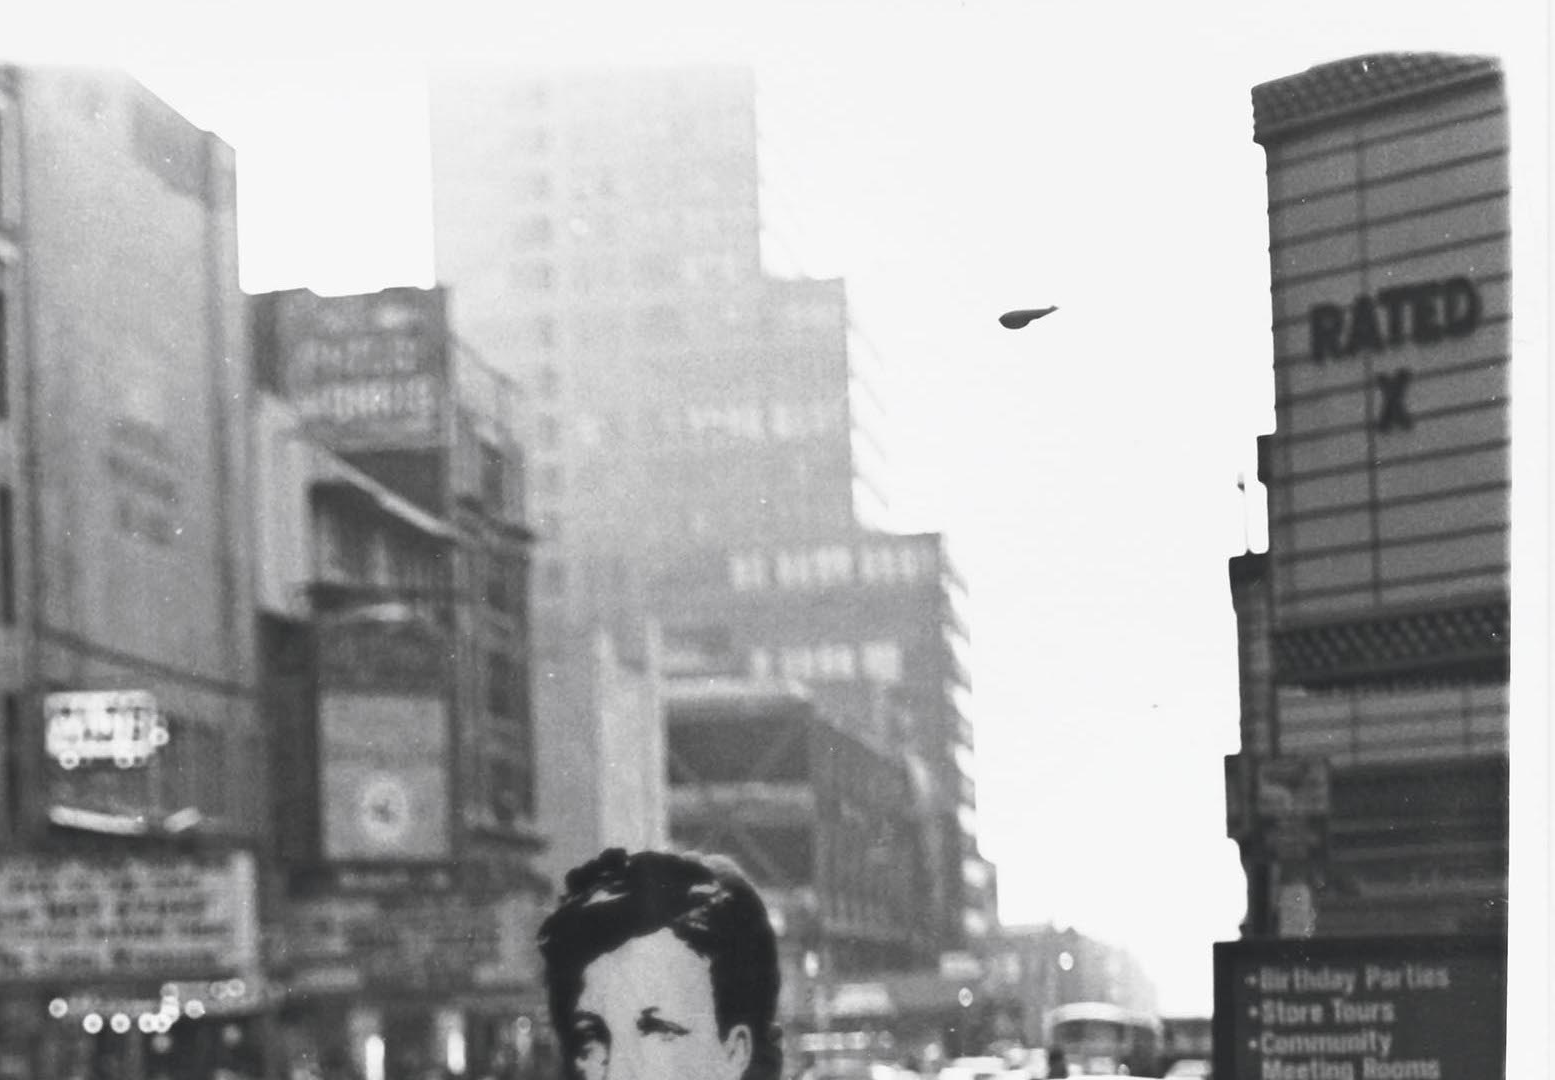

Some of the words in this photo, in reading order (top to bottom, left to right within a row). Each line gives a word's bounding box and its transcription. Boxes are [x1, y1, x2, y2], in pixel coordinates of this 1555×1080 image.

[1309, 276, 1482, 365] RATED
[1375, 368, 1414, 432] X
[1260, 965, 1357, 996] Birthday
[1365, 963, 1451, 991] Parties
[1261, 998, 1324, 1025] Store
[1332, 997, 1396, 1023] Tours
[1260, 1030, 1393, 1058] Community
[1363, 1056, 1442, 1080] Rooms
